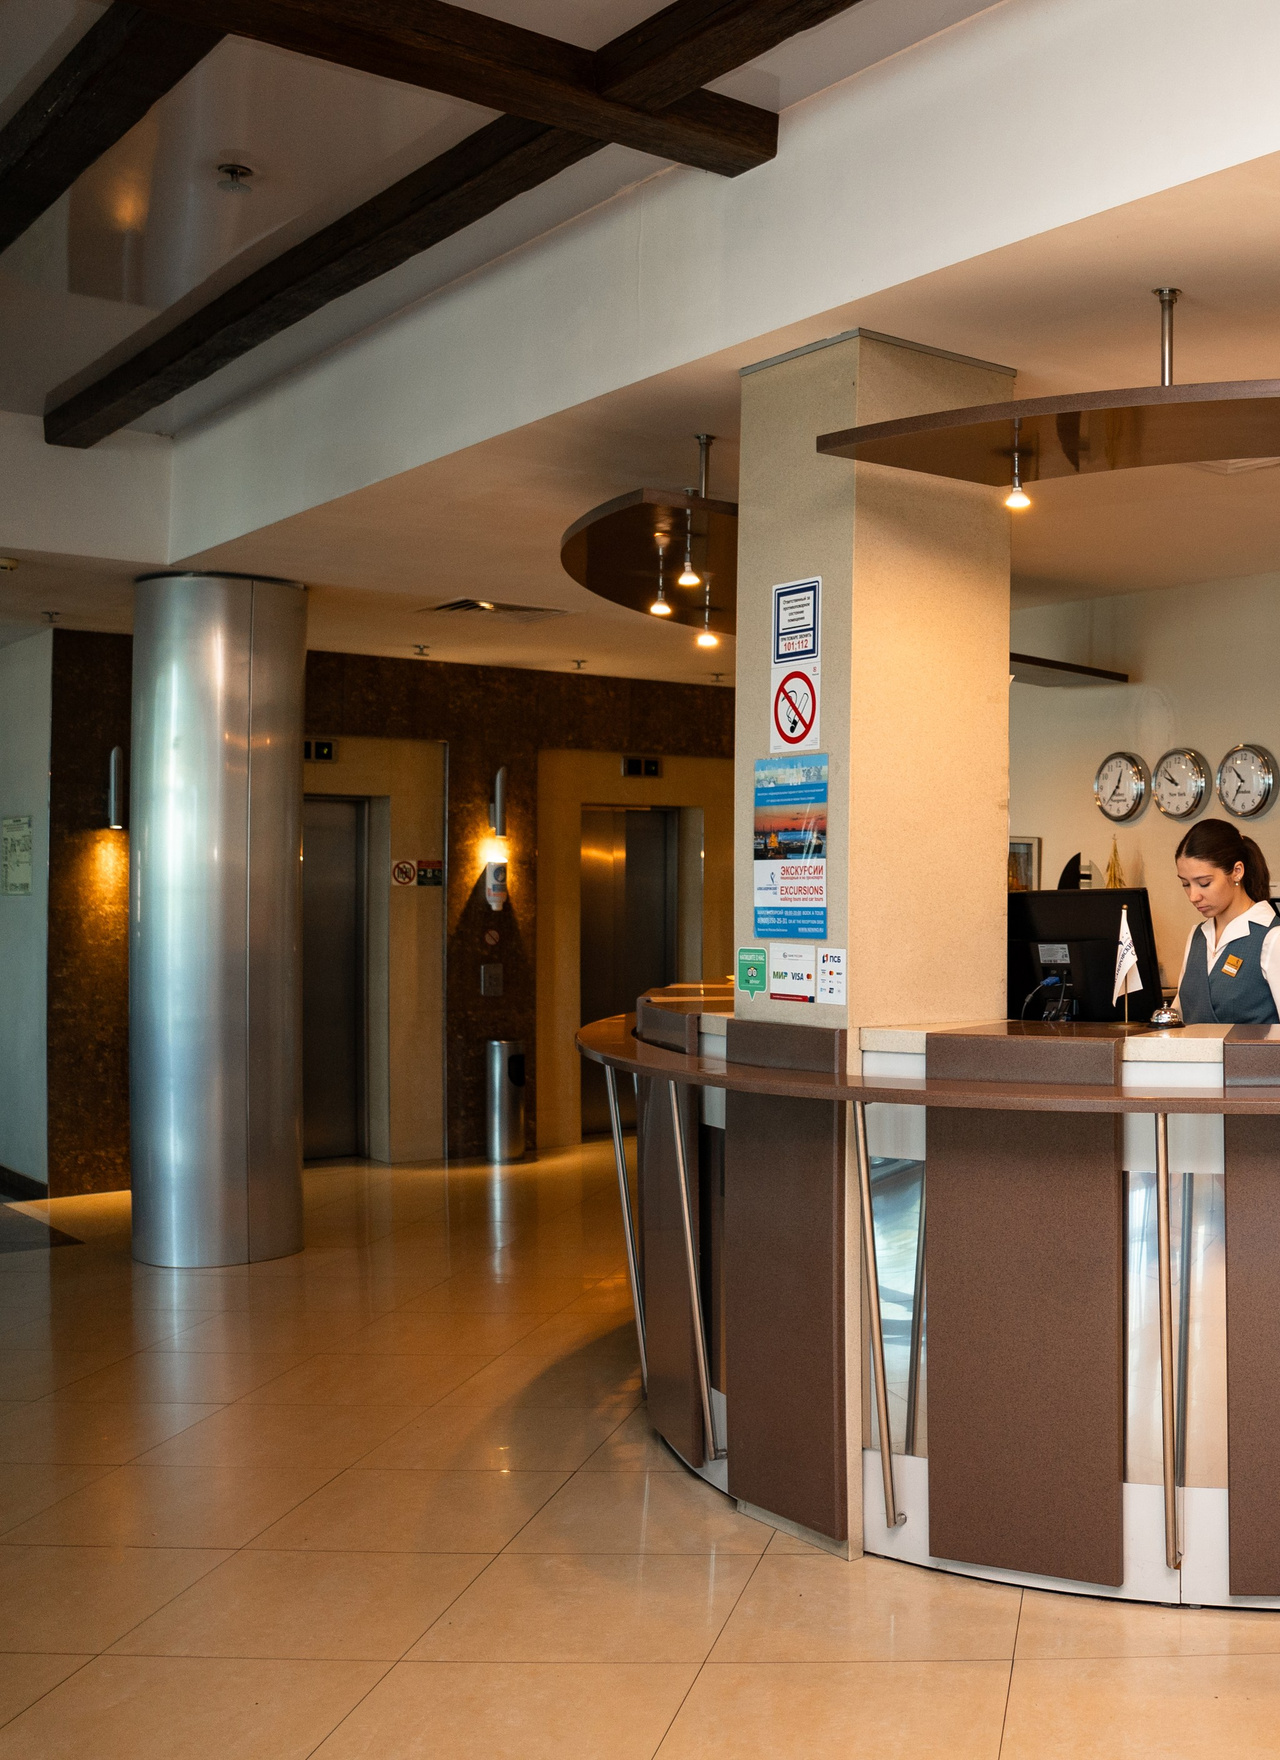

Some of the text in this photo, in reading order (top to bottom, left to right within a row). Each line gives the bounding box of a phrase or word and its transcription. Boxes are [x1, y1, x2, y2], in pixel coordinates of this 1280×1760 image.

[1115, 760, 1122, 768] 12
[1174, 756, 1181, 764] 12
[1108, 764, 1113, 772] 11
[1166, 761, 1171, 769] 11
[1225, 765, 1232, 773] 10
[1102, 772, 1109, 780] 10
[780, 865, 823, 876] ЭКСКУРСИИ
[780, 886, 823, 895] EXCURSIONS
[829, 955, 841, 963] ПСБ
[773, 971, 788, 979] МИР
[791, 972, 804, 981] VISA
